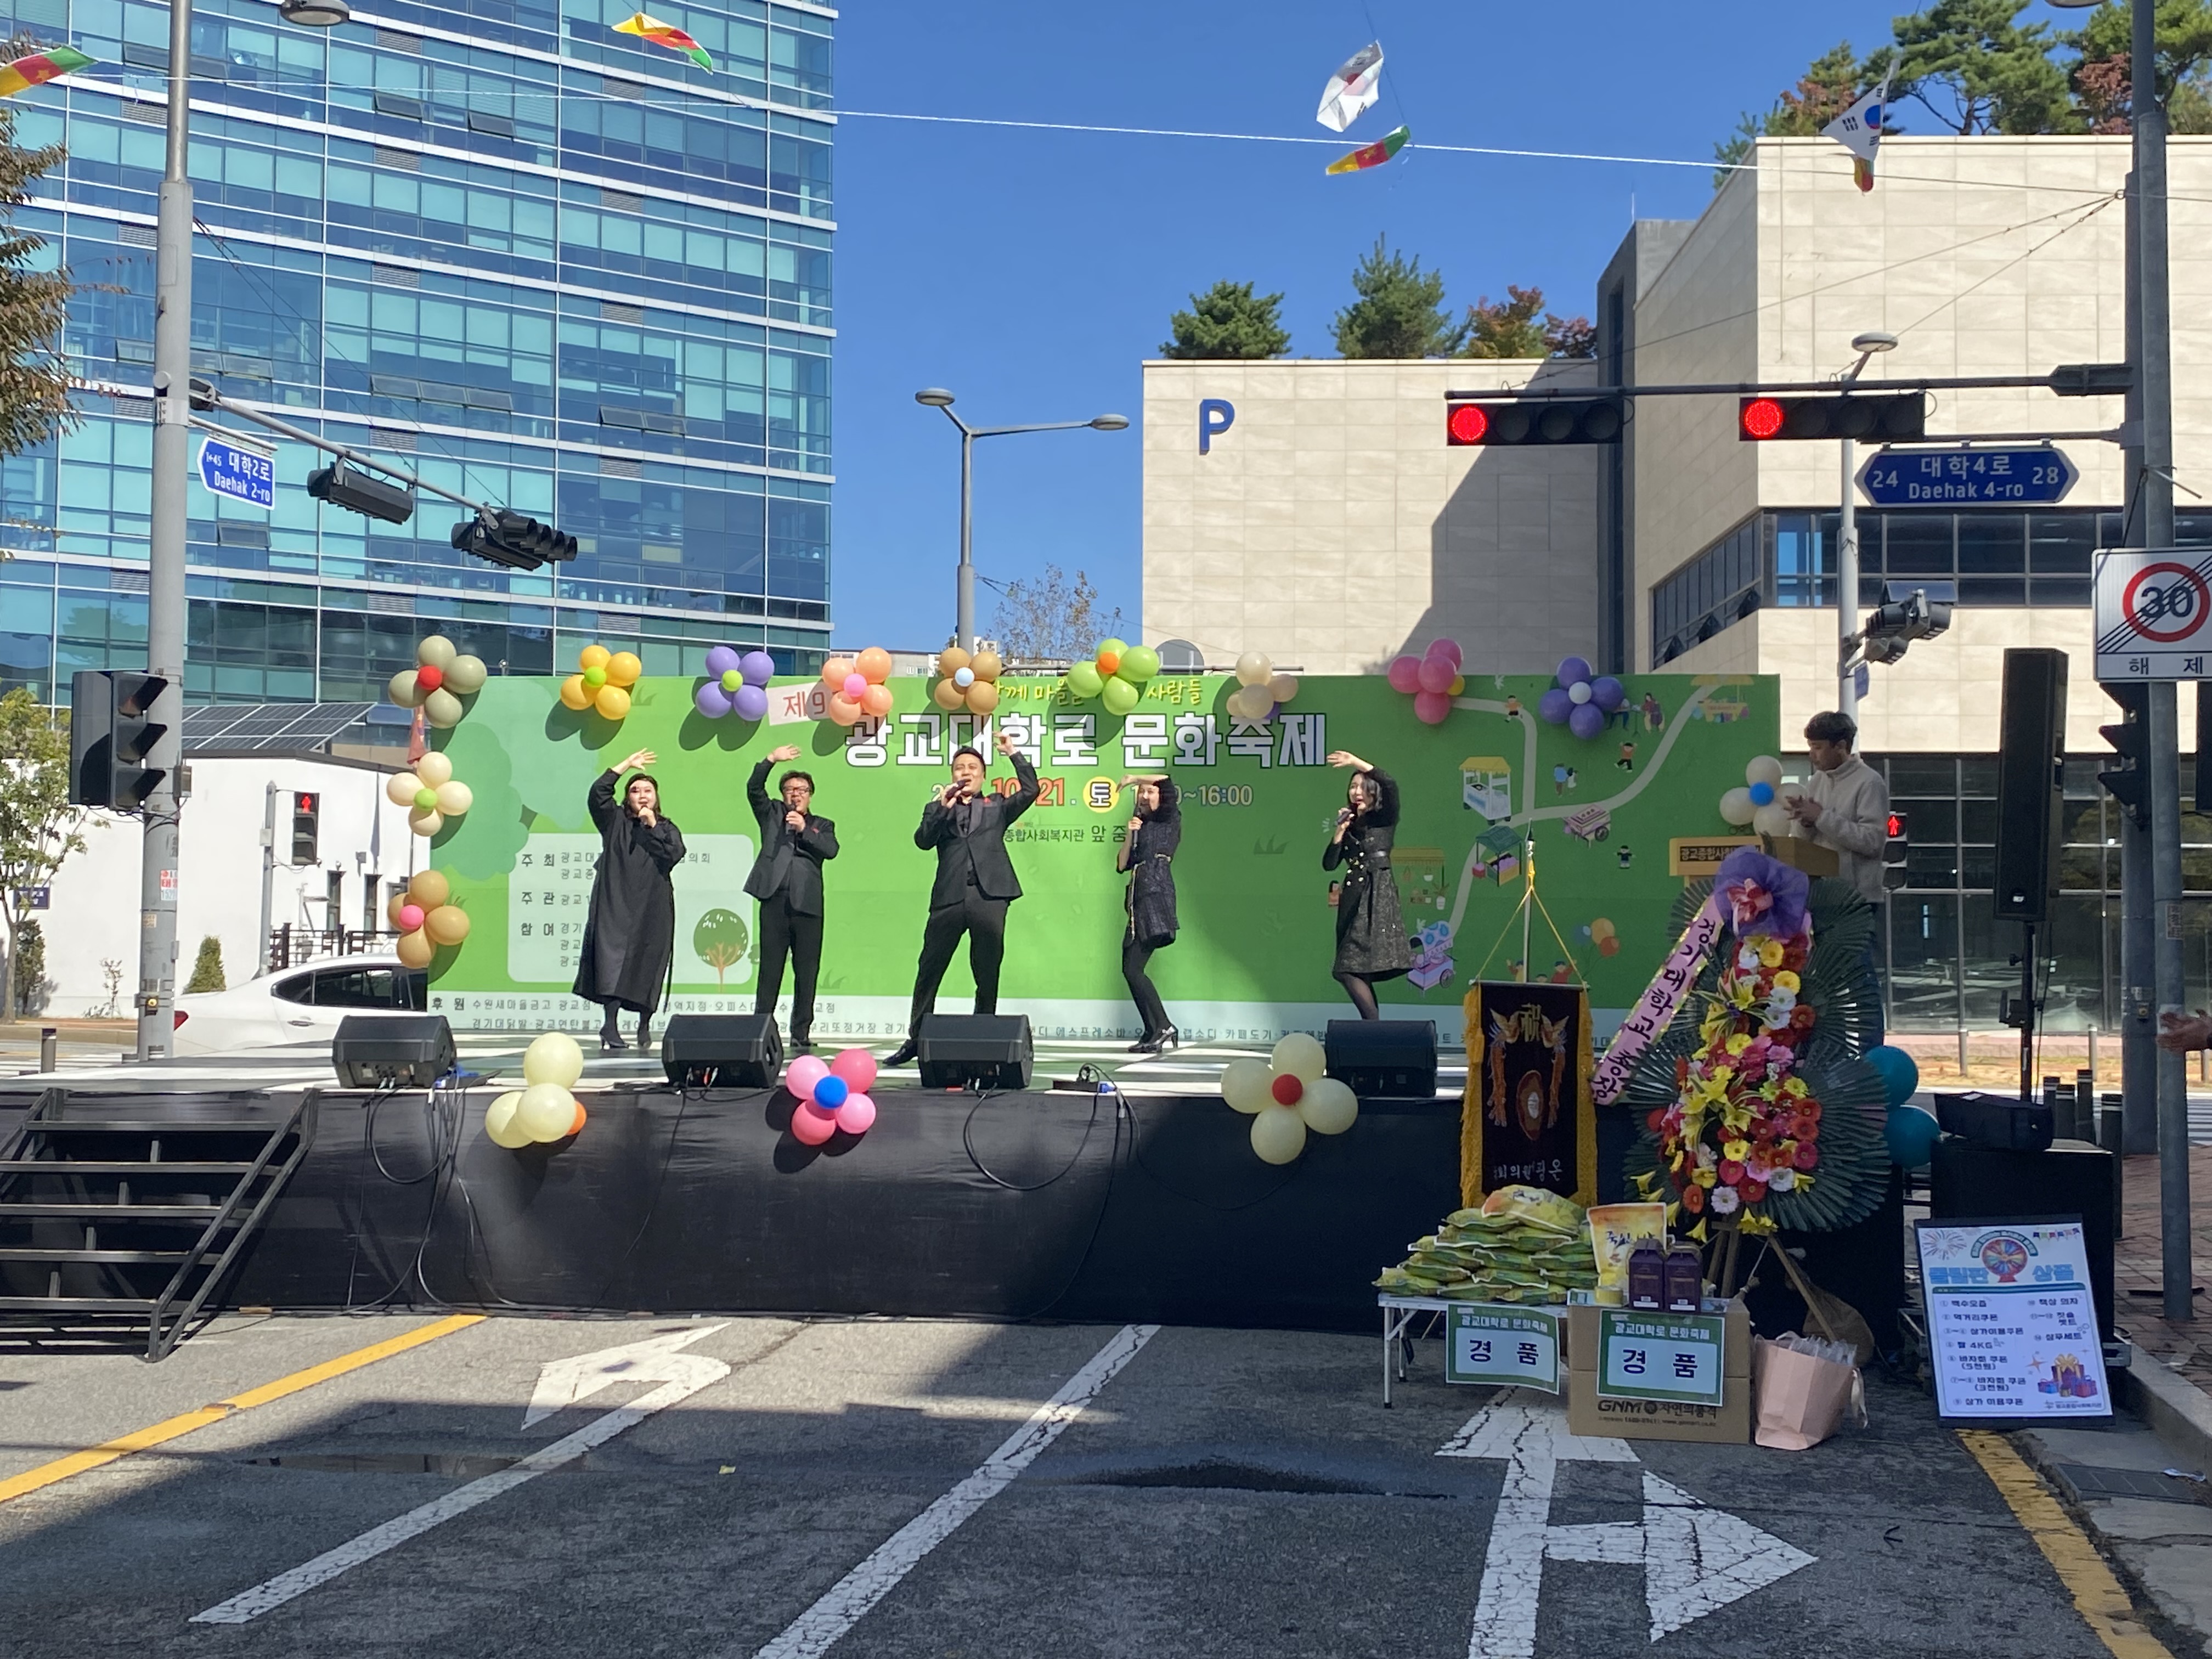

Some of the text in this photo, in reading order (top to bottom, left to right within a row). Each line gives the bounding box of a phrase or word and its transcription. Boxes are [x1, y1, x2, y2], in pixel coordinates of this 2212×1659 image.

[1199, 399, 1235, 455] P
[229, 451, 270, 482] 대학2로
[1872, 455, 2059, 488] 24 대학4로 28
[214, 470, 270, 503] Daehak 2-ro
[1909, 482, 2024, 500] Daehak 4-ro
[2141, 585, 2194, 619] 30
[1147, 679, 1203, 706] 사람들
[783, 691, 826, 717] 제9
[845, 711, 1327, 769] 광교대학로 문화축제
[1090, 782, 1111, 808] 토
[1005, 829, 1085, 842] 종합사회복지관
[1112, 825, 1127, 842] 중
[561, 852, 601, 863] 광교대
[561, 868, 594, 880] 광교종
[561, 894, 590, 906] 광교1
[561, 923, 582, 934] 경기
[560, 940, 580, 950] 광교
[560, 956, 580, 967] 광교
[1598, 1400, 1643, 1414] GNM
